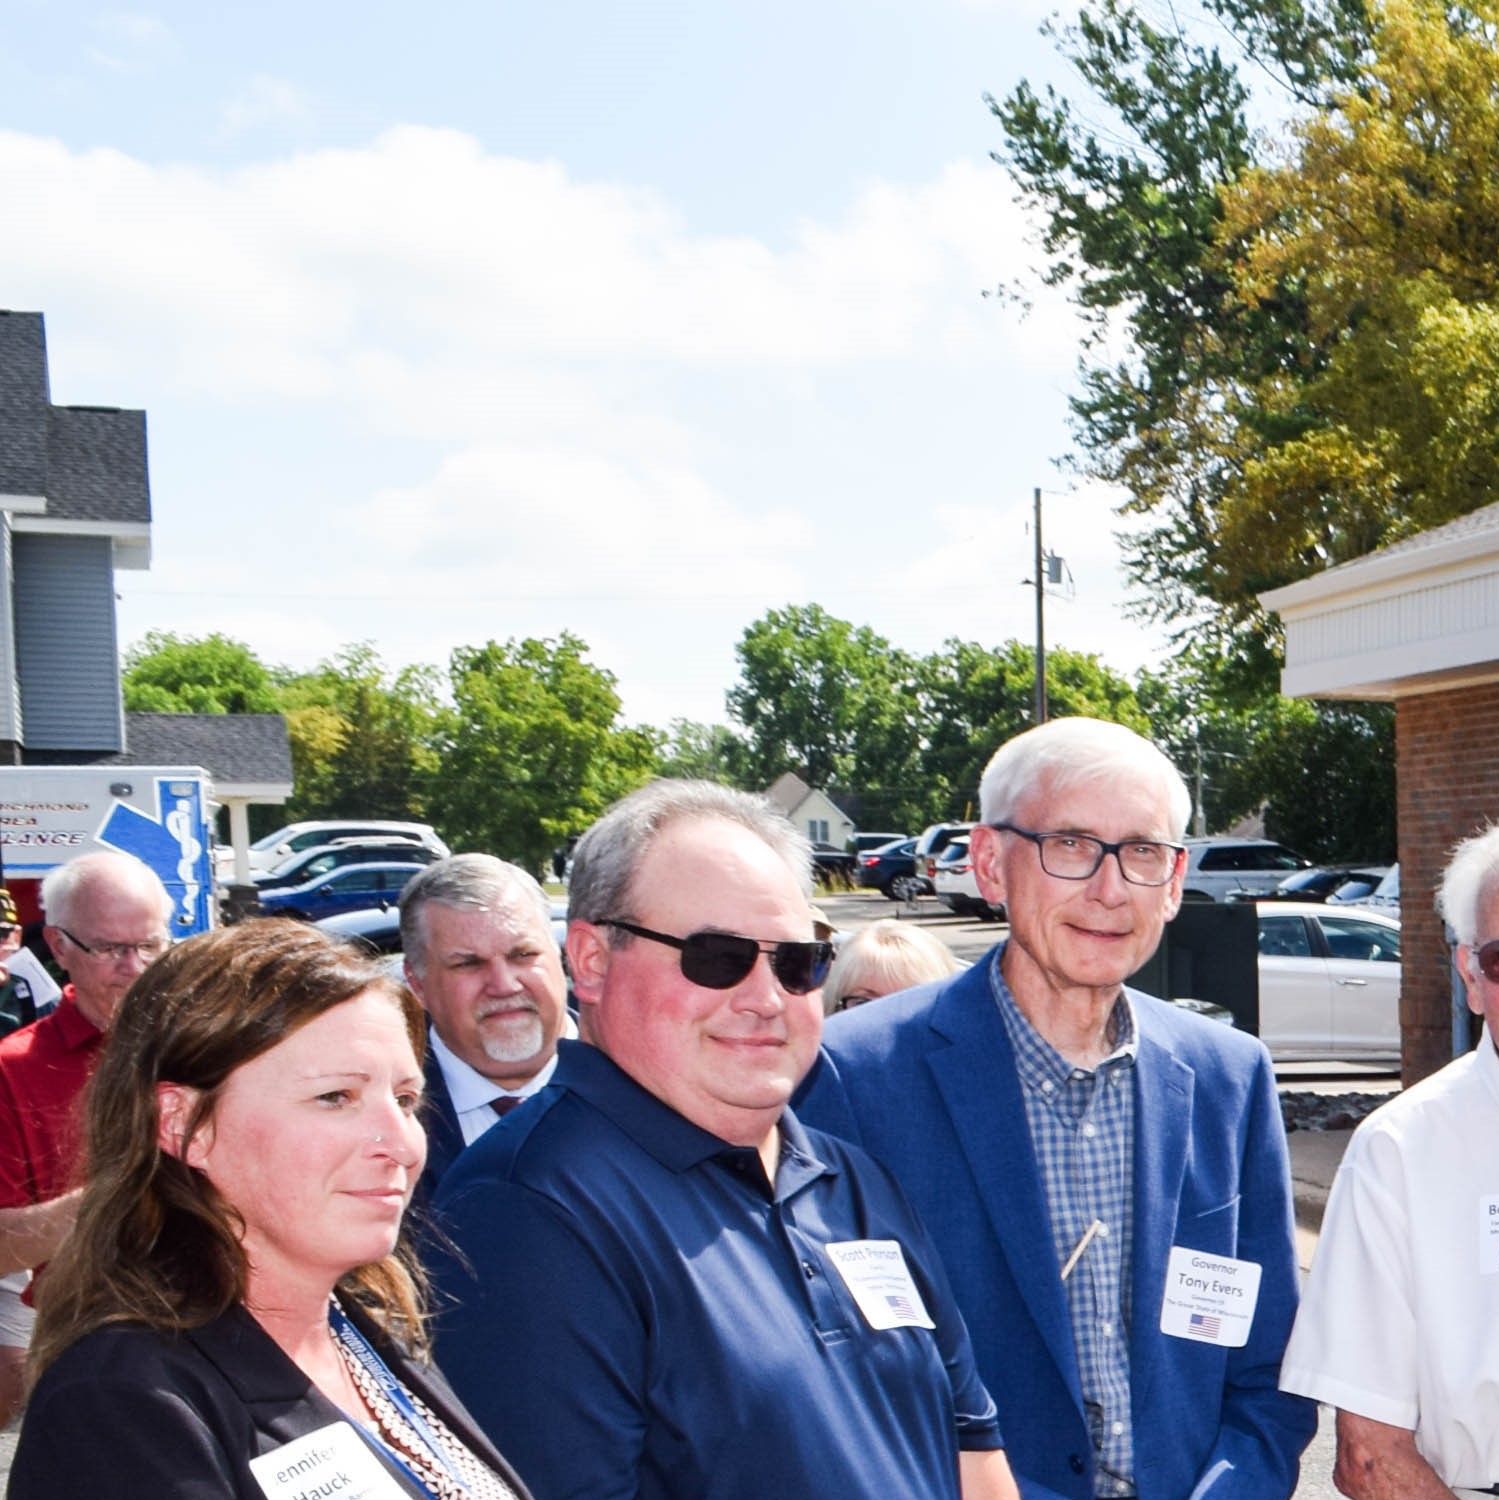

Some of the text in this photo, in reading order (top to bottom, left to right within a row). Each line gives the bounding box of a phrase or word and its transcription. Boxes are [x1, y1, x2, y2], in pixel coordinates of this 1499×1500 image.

[1191, 1257, 1238, 1275] Governor
[1178, 1273, 1244, 1297] Tony Evers
